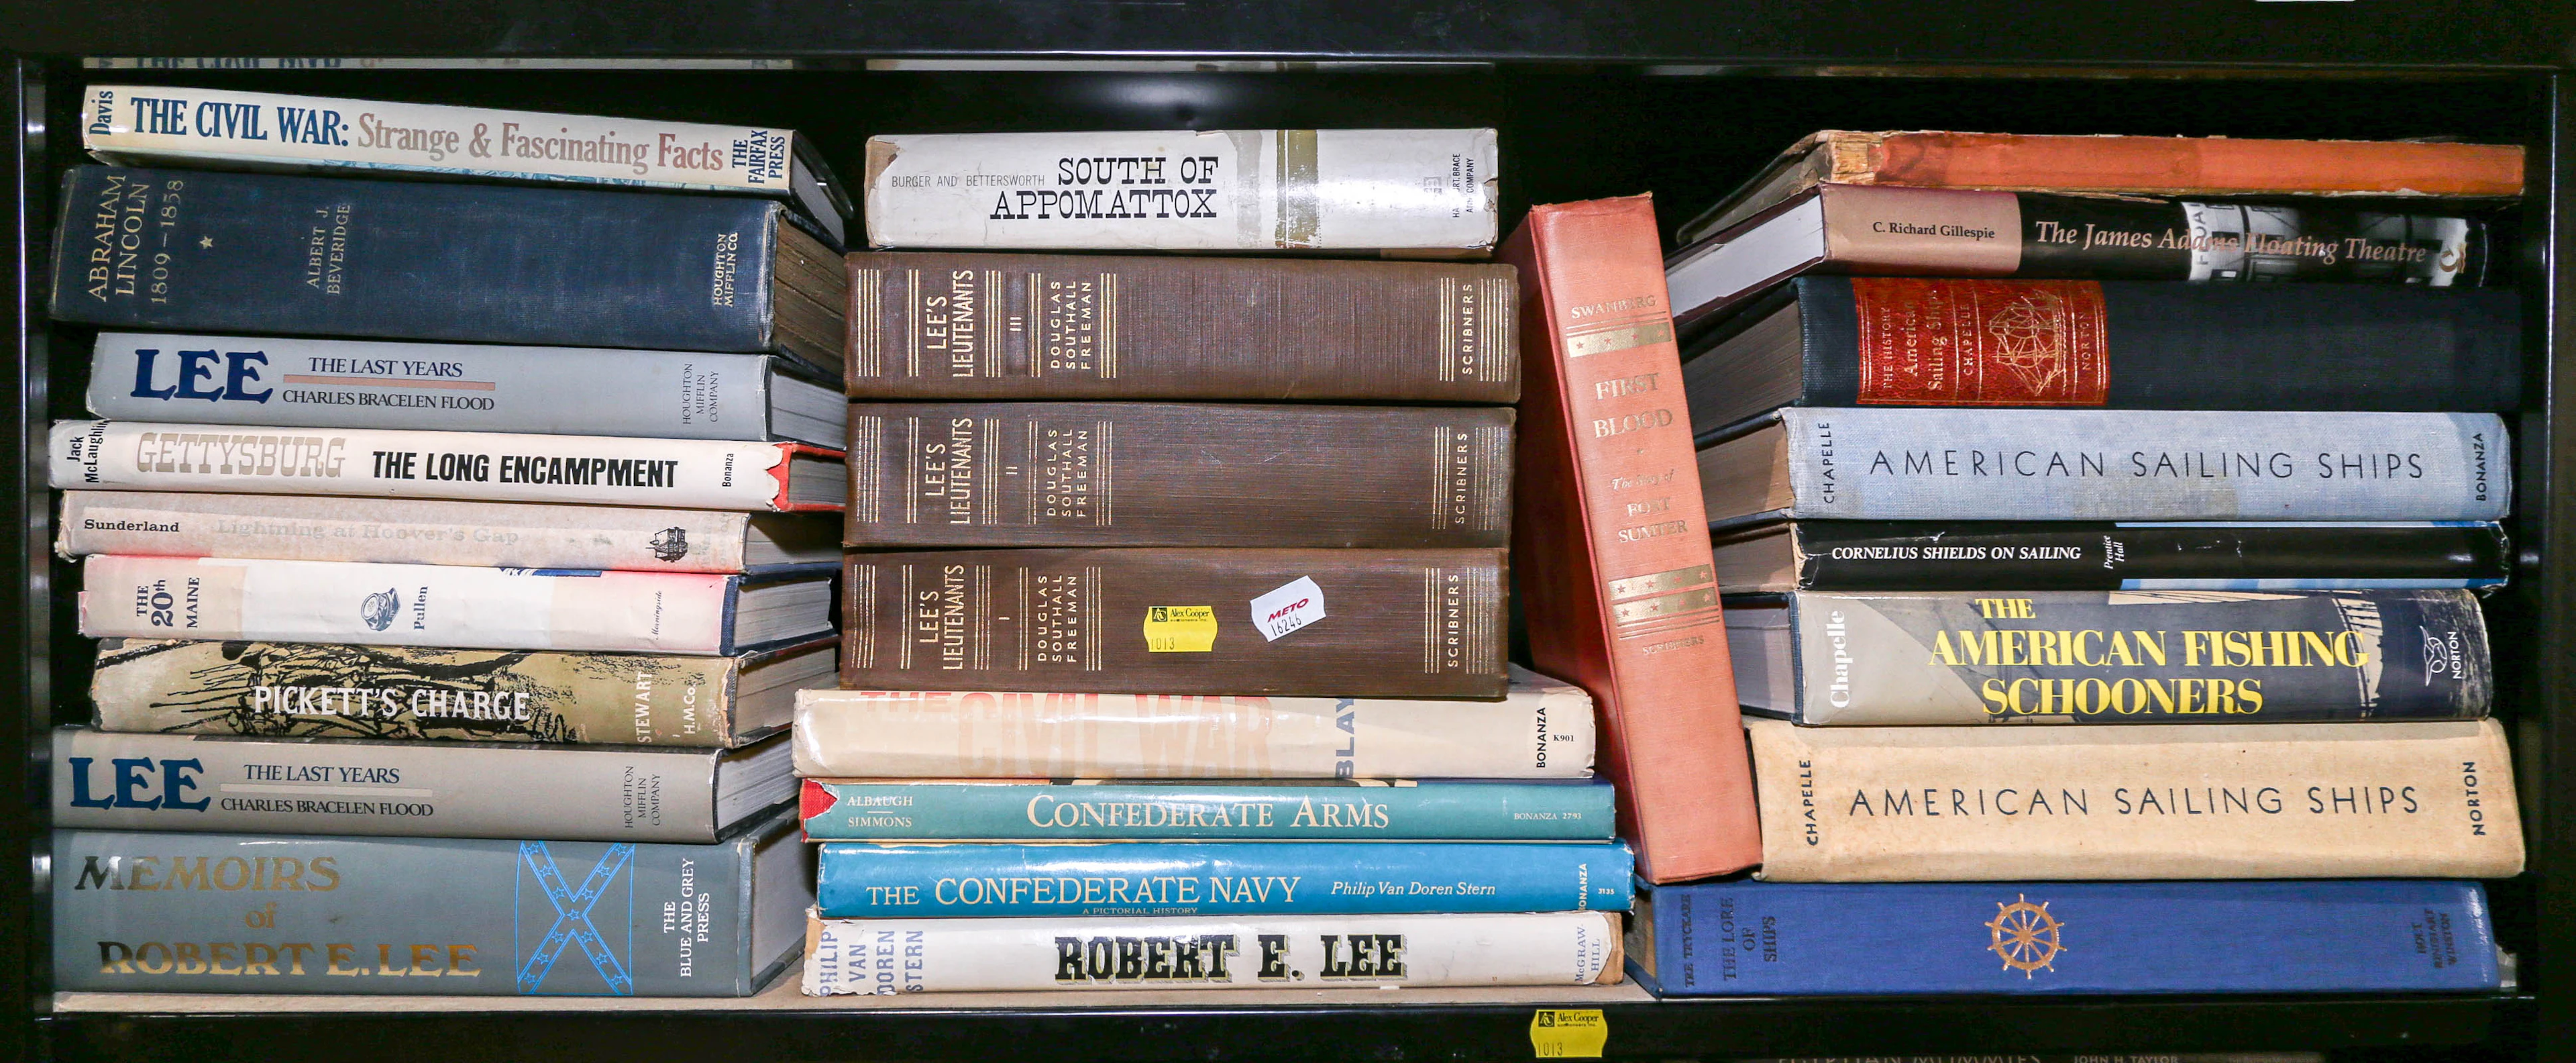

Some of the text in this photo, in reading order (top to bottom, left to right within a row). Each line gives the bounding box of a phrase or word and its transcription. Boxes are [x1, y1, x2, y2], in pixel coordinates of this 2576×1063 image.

[89, 91, 113, 136] Davis
[131, 97, 723, 175] THE CIVIL WAR: Strange & Fascinating Facts
[732, 140, 747, 168] THE
[749, 130, 767, 184] FAIRFAX
[769, 136, 786, 179] PRESS
[1058, 156, 1219, 186] SOUTH OF
[1452, 153, 1461, 176] BRACE
[1466, 158, 1474, 193] COMPANY
[892, 174, 1045, 188] BURGER AND BETTERSWORTH
[989, 189, 1218, 219] APPOMATTOX
[89, 175, 125, 302] ABRAHAM
[116, 183, 150, 296] LINCOLN
[307, 206, 329, 288] ALBERT J.
[327, 203, 350, 295] BEVERIDGE
[1873, 222, 1995, 241] C. Richard Gillespie
[2035, 220, 2426, 266] The James Adams Floating Theatre
[712, 233, 728, 307] HOUGHTON
[724, 254, 737, 307] MIFFLIN
[927, 295, 947, 350] LEE'S
[953, 270, 974, 377] LIEUTENANTS
[1051, 281, 1061, 369] DOUGLAS
[1065, 281, 1076, 370] SOUTHALL
[1081, 282, 1091, 370] FREEMAN
[1571, 295, 1658, 319] SWANBERG
[1462, 283, 1472, 375] SCRIBNERS
[1881, 307, 1893, 389] THE HISTORY
[130, 349, 274, 404] LEE
[309, 357, 463, 378] THE LAST YEARS
[1927, 336, 1948, 391] Sailing
[282, 389, 494, 411] CHARLES BRACELEN FLOOD
[682, 363, 692, 425] HOUGHTON
[696, 374, 706, 414] MIFFLIN
[709, 370, 719, 423] COMPANY
[1595, 372, 1660, 400] FIRST
[1593, 409, 1673, 438] BLOOD
[66, 435, 85, 462] Jack
[136, 432, 678, 488] GETTYSBURG THE LONG ENCAMPMENT
[1819, 422, 1835, 504] CHAPELLE
[1870, 450, 2423, 479] AMERICAN SAILING SHIPS
[2472, 432, 2487, 502] BONANZA
[722, 453, 735, 488] Bonanza
[925, 443, 947, 497] LEE'S
[951, 417, 973, 525] LIEUTENANTS
[1047, 429, 1057, 516] DOUGLAS
[1062, 429, 1073, 517] SOUTHALL
[1077, 430, 1087, 517] FREEMAN
[1455, 433, 1468, 524] SCRIBNERS
[84, 519, 180, 533] Sunderland
[1626, 497, 1671, 517] FORT
[217, 519, 519, 547] Lightning at Hoover's Gap
[1617, 519, 1688, 543] SUMTER
[1832, 546, 2081, 560] CORNELIUS SHIELDS ON SAILING
[2103, 535, 2114, 570] Prentice
[2114, 542, 2125, 562] Hall
[137, 585, 148, 617] THE
[151, 579, 174, 627] 20th
[186, 576, 200, 629] MAINE
[414, 586, 429, 631] Pullen
[651, 590, 663, 641] Morningside
[1171, 607, 1210, 619] Alex Cooper
[1267, 598, 1309, 623] METO
[1975, 598, 2036, 619] THE
[1150, 637, 1175, 650] 1013
[1271, 613, 1303, 637] 16246
[1827, 610, 1854, 709] Chapelle
[1929, 629, 2370, 668] AMERICAN FISHING
[2448, 631, 2462, 679] NORTON
[254, 685, 530, 721] PICKETT'S CHARGE
[635, 670, 653, 744] STEWART
[1982, 678, 2263, 715] SCHOONERS
[1336, 697, 1355, 778] BLAY
[1536, 707, 1546, 768] BONANZA
[1552, 733, 1575, 743] K901
[624, 766, 635, 829] HOUGHTON
[638, 778, 647, 818] MIFFLIN
[651, 774, 661, 826] COMPANY
[847, 795, 913, 807] ALBAUGH
[1026, 795, 1389, 829] CONFEDERATE ARMS
[1513, 812, 1582, 821] BONANZA 2793
[1799, 760, 1819, 846] CHAPELLE
[2462, 761, 2487, 836] NORTON
[848, 816, 912, 828] SIMMONS
[74, 856, 340, 893] MEMOIRS
[865, 876, 1301, 906] THE CONFEDERATE NAVY
[1331, 882, 1496, 897] Philip Van Doren Stern
[1597, 887, 1615, 895] 3135
[245, 902, 276, 929] of
[663, 901, 676, 933] THE
[680, 858, 694, 978] BLUE AND GREY
[698, 892, 710, 942] PRESS
[1153, 907, 1198, 915] HISTORY
[97, 940, 315, 976] ROBERT
[1591, 938, 1599, 972] HILL
[1720, 897, 1736, 981] THE LORE
[1742, 927, 1756, 952] OF
[1762, 915, 1778, 962] SHIPS
[849, 945, 867, 982] VAN
[876, 931, 896, 996] DOREN
[905, 930, 924, 992] STERN
[1055, 934, 1407, 985] ROBERT E. LEE
[1558, 1012, 1599, 1024] Alex Cooper
[1538, 1042, 1563, 1056] 1013
